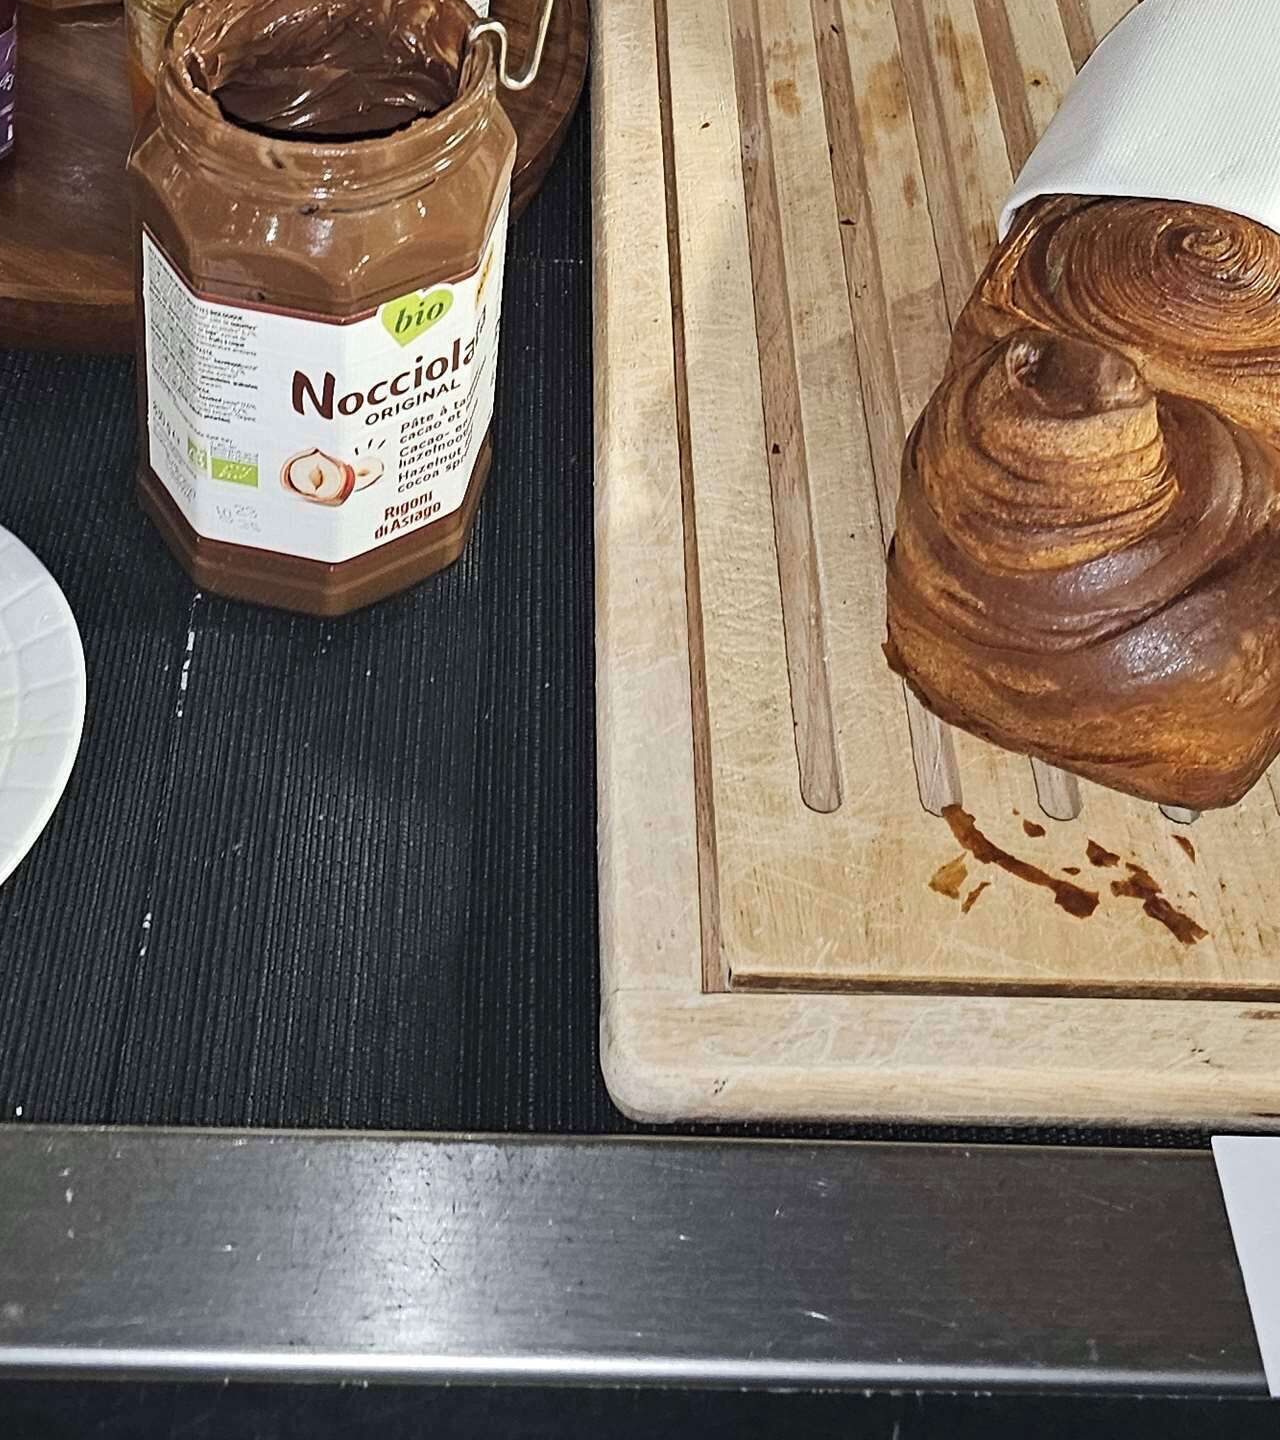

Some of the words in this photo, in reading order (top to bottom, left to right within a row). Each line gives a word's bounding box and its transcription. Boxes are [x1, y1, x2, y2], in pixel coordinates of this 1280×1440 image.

[393, 296, 446, 336] bio
[364, 379, 462, 427] ORIGINAL
[399, 410, 435, 435] Pâte
[440, 404, 449, 417] à
[398, 420, 443, 445] cacao
[447, 409, 463, 424] et
[398, 431, 451, 459] Cacao-
[397, 446, 463, 484] Hazelnut
[397, 470, 440, 495] cocoa
[374, 524, 389, 541] di
[389, 500, 443, 535] Asiago
[383, 489, 434, 521] Rigoni
